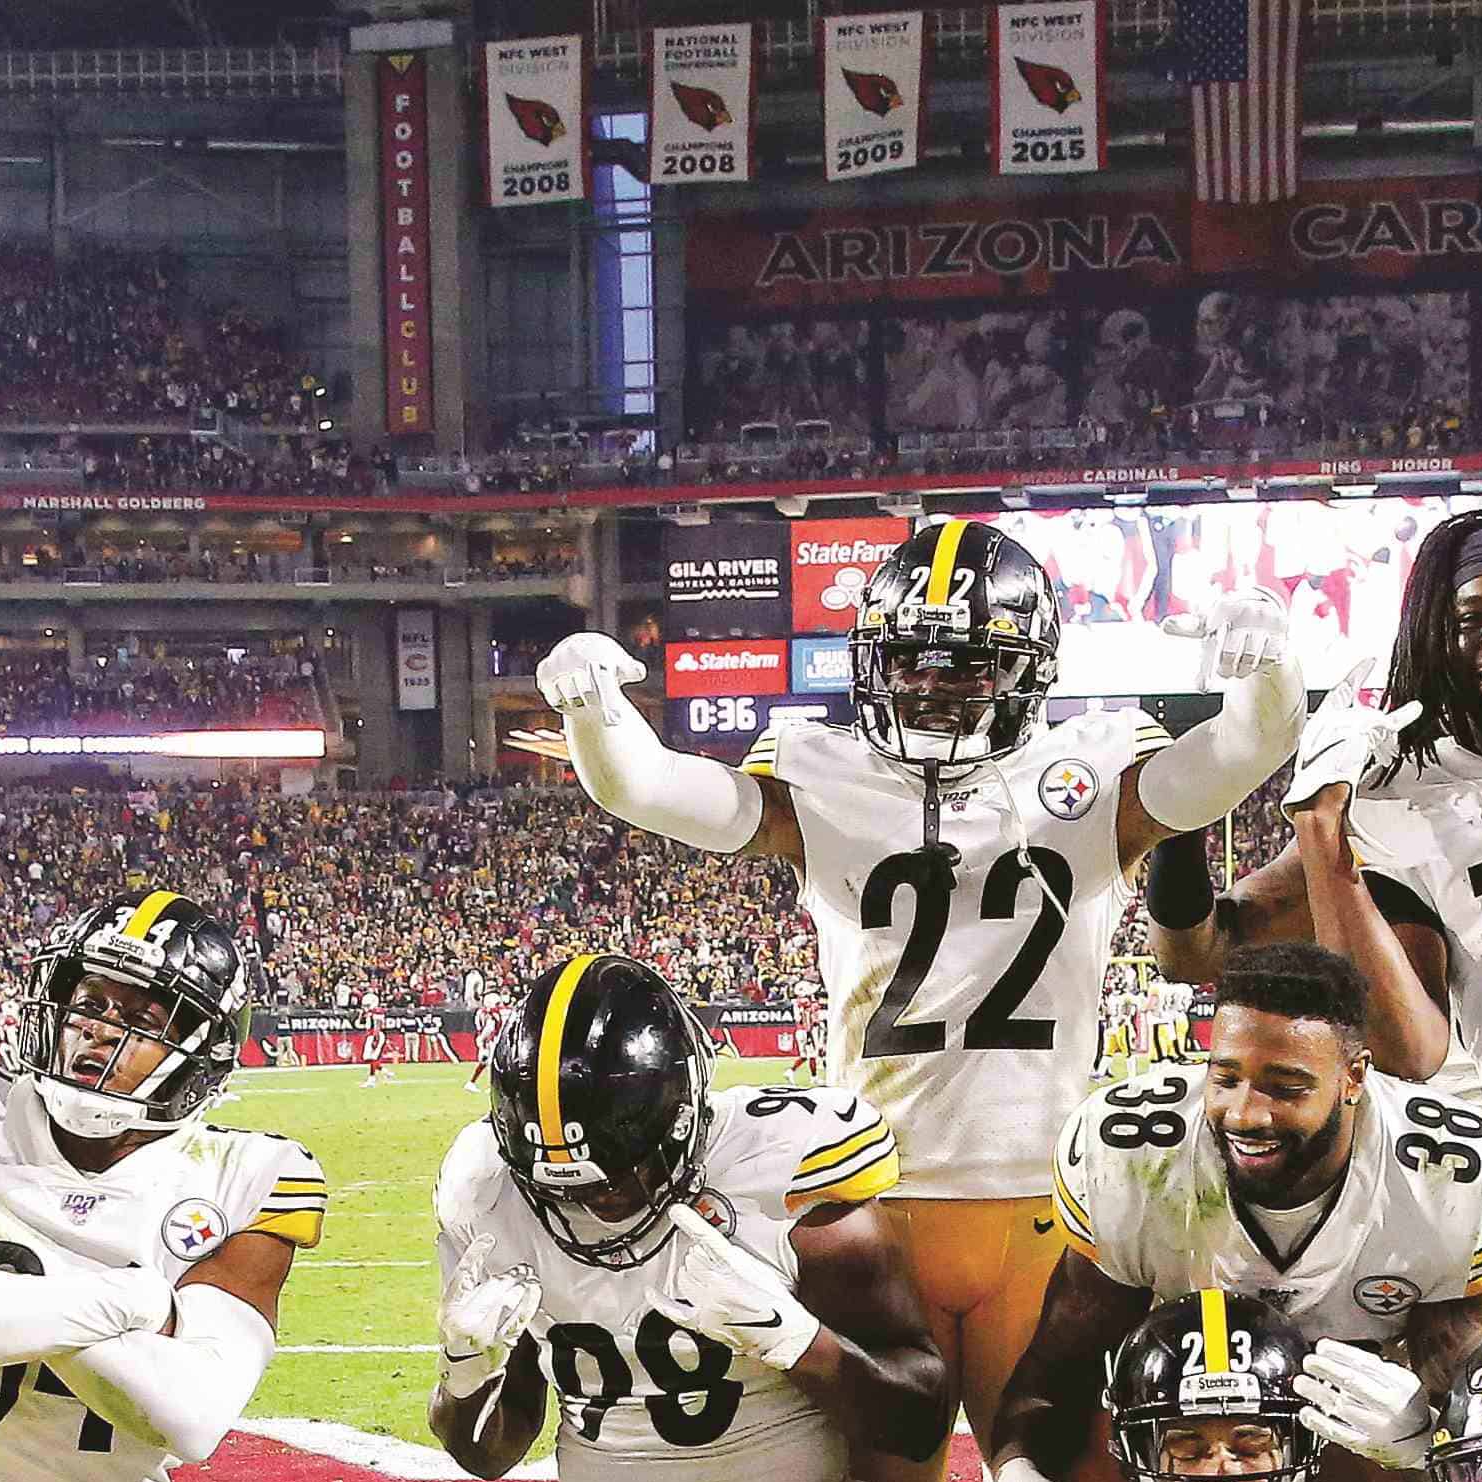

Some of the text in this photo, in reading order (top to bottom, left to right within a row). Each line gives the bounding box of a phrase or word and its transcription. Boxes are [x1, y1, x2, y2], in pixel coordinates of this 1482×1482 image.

[837, 21, 909, 37] NFC WEST
[1011, 14, 1082, 28] NFC WEST
[665, 34, 738, 47] NATIONAL
[530, 46, 569, 59] WEST
[665, 47, 738, 60] FOOTBALL
[837, 140, 904, 172] 2009
[1012, 139, 1085, 163] 2015
[662, 154, 735, 175] 2008
[503, 173, 570, 196] 2008
[394, 94, 416, 311] FOOTBALL
[756, 213, 1182, 288] ARIZONA
[400, 320, 419, 423] CLUB
[1083, 468, 1179, 483] CARDINALS
[1320, 460, 1362, 475] RING
[1392, 458, 1453, 473] HONOR
[23, 496, 206, 511] MARSHALL GOLDBERG
[669, 559, 779, 578] GILA RIVER
[904, 566, 975, 603] 22
[699, 652, 780, 671] StateFarm
[689, 698, 758, 733] 0:36
[107, 906, 179, 947] 34
[860, 844, 1074, 1060] 22
[287, 1017, 353, 1031] RIZONA
[721, 1010, 793, 1023] ARIZONA
[1099, 1077, 1188, 1149] 38
[1180, 1330, 1253, 1376] 23
[545, 1302, 746, 1447] 98
[1197, 1375, 1241, 1390] Steelers
